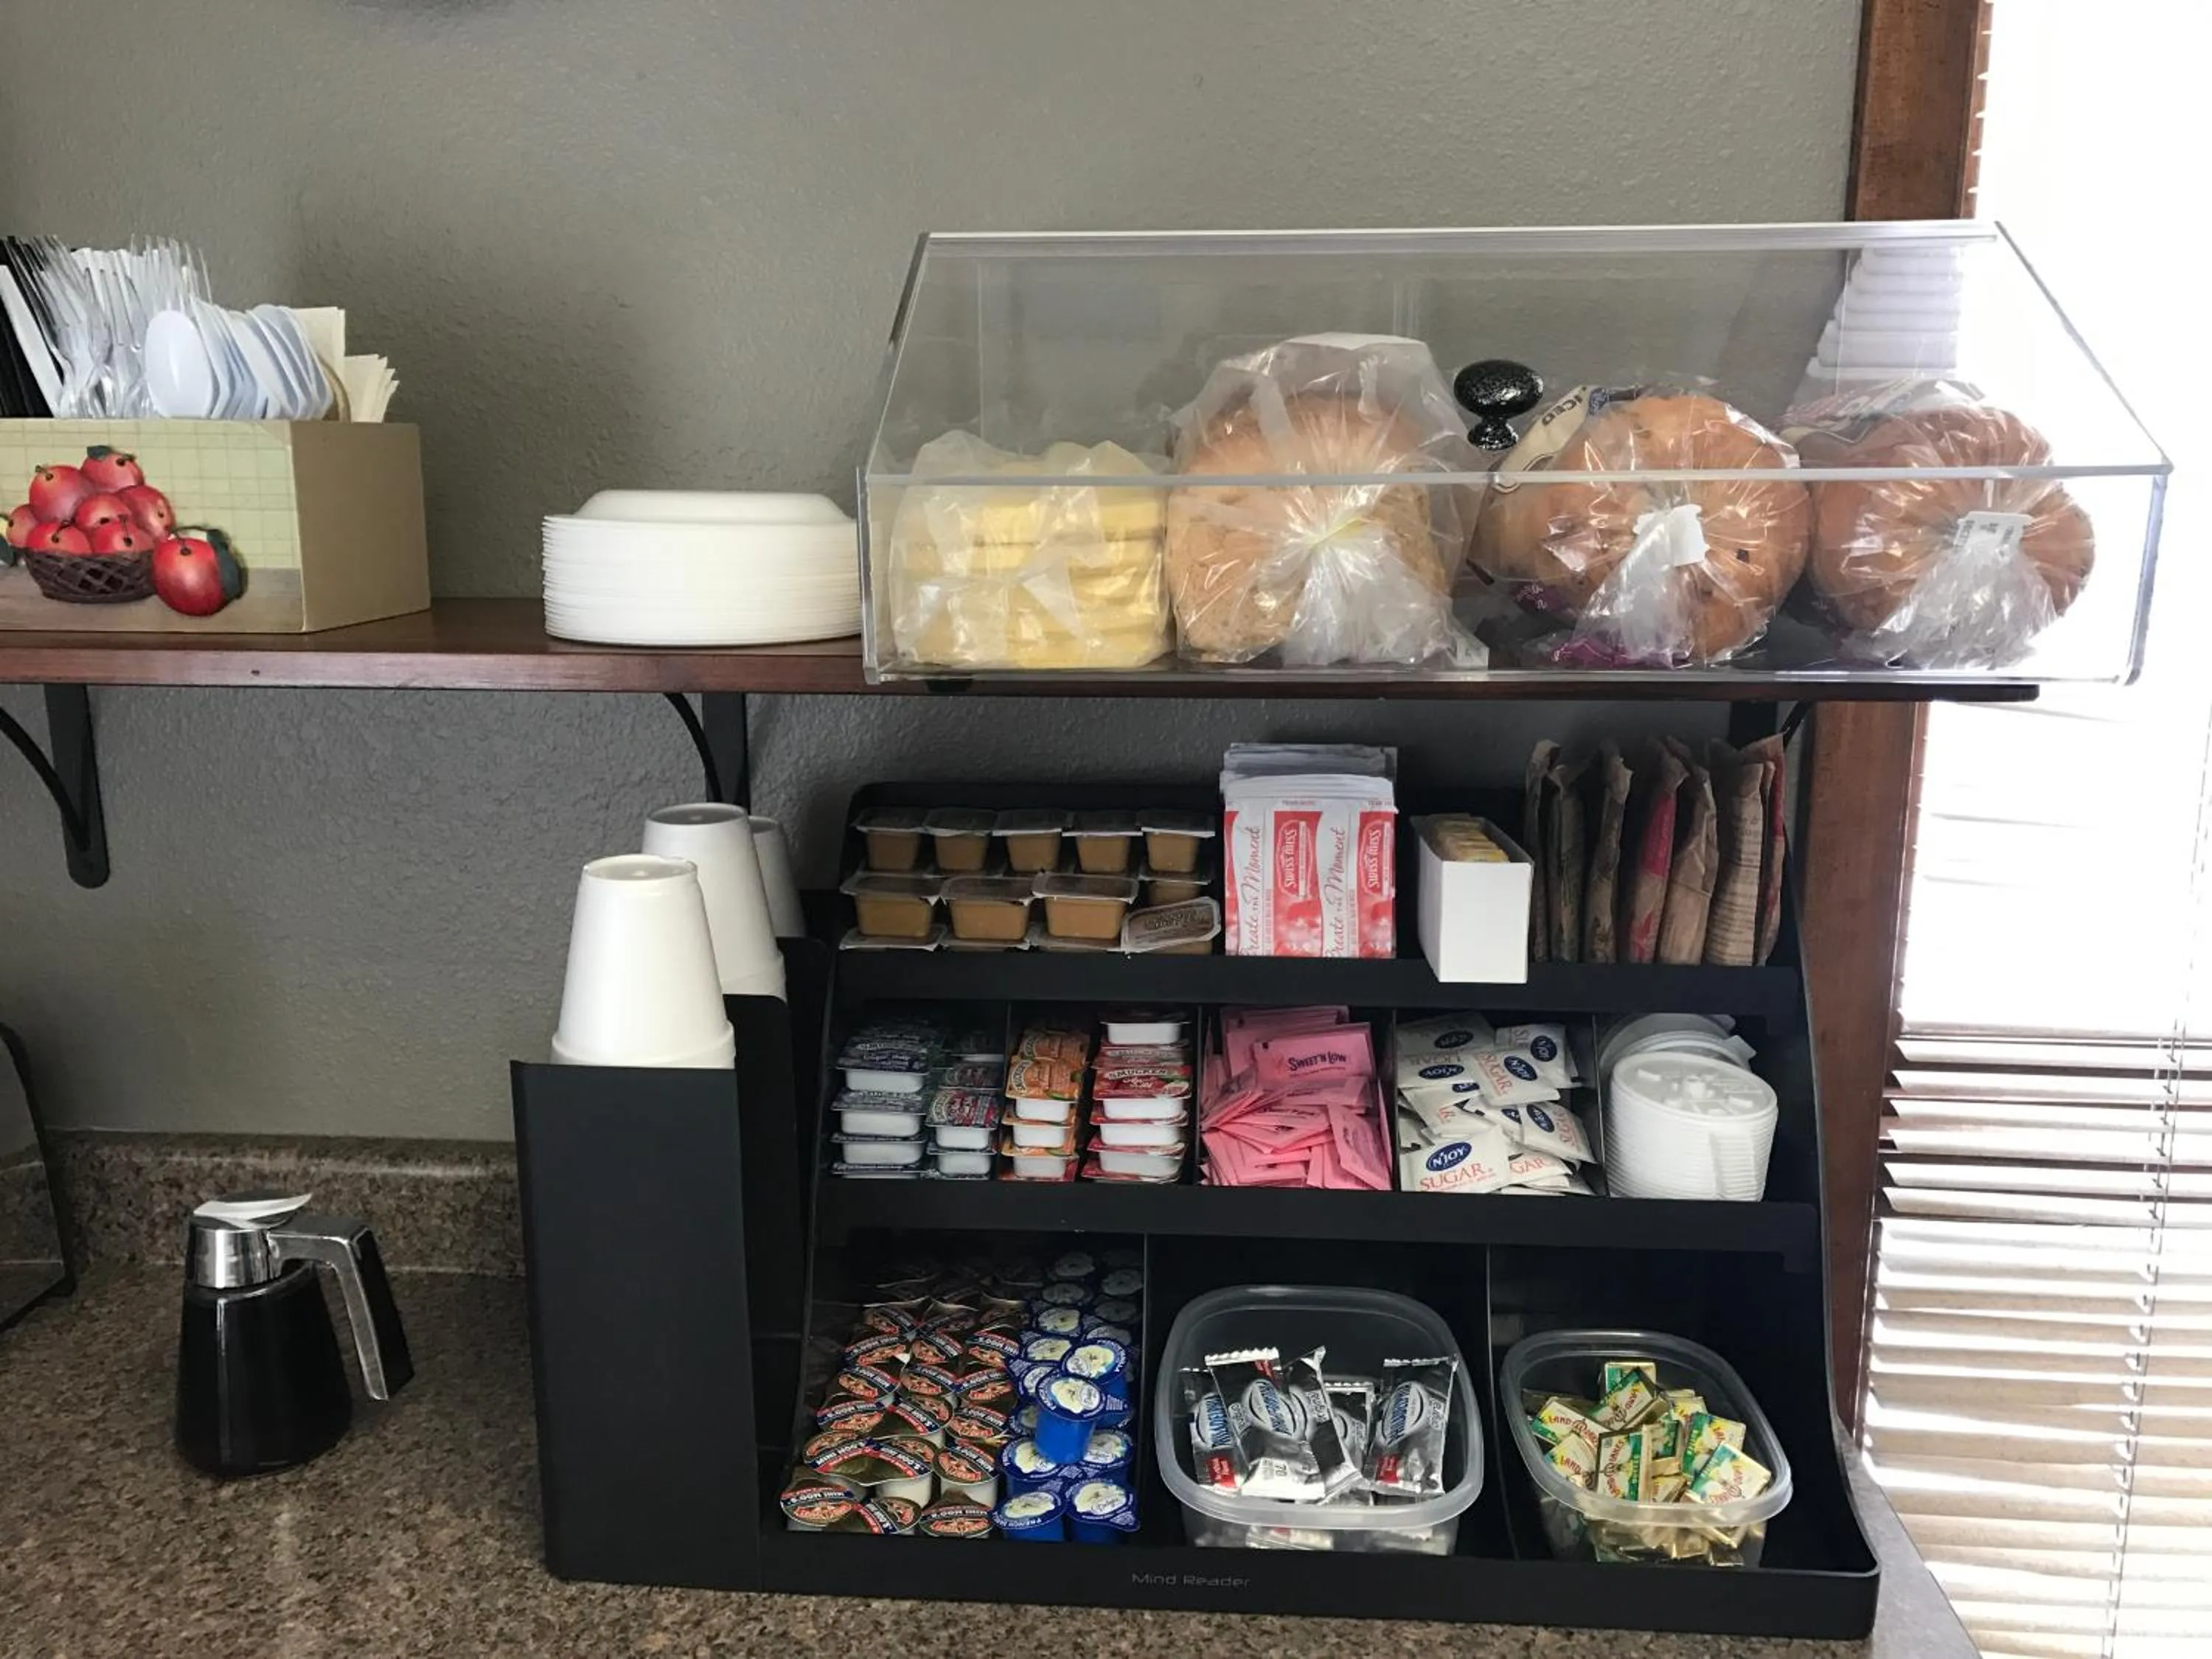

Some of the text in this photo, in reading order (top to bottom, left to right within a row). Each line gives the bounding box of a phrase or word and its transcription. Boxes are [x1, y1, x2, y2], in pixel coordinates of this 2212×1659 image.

[1284, 829, 1298, 888] SWISS MISS
[1368, 856, 1381, 888] SWISS
[1432, 1146, 1467, 1168] N'JOY
[1419, 1163, 1486, 1191] SUGAR
[1559, 1455, 1582, 1475] LAND
[1132, 1572, 1251, 1587] Mind Reader
